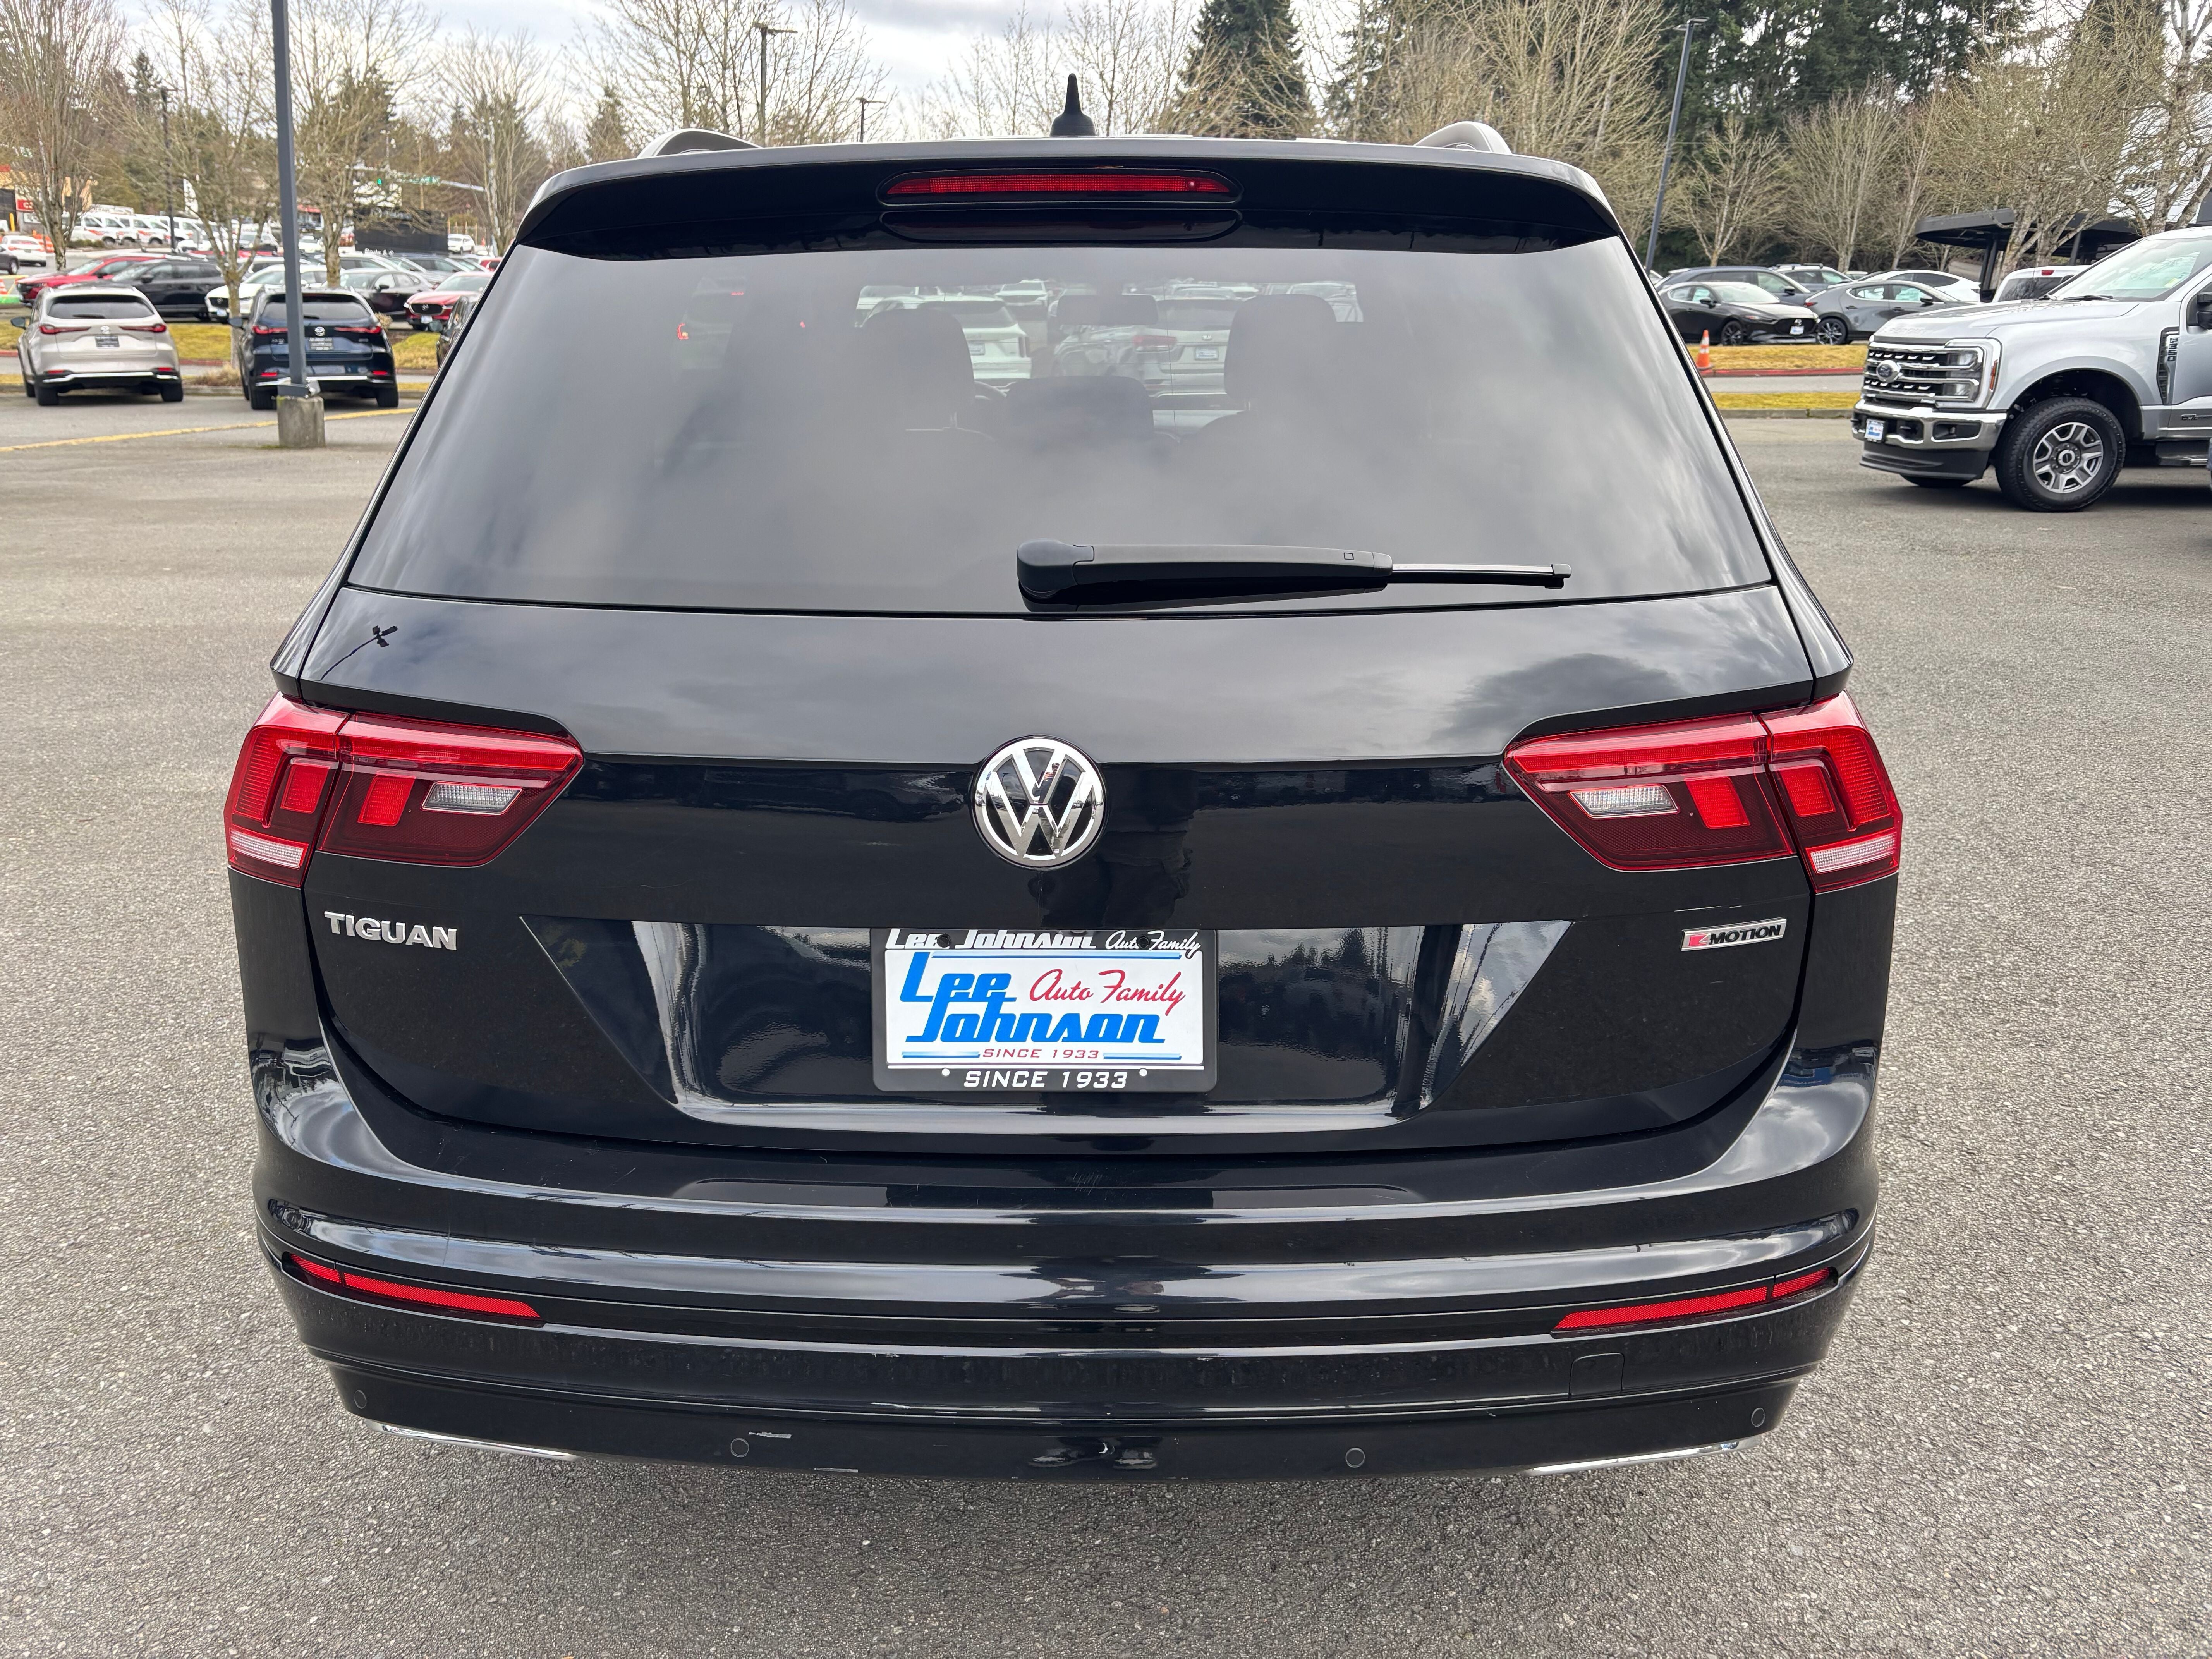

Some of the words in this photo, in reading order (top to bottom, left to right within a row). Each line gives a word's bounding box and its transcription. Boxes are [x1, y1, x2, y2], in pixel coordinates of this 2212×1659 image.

[324, 911, 457, 951] TIGUAN
[885, 928, 950, 949] Lee
[955, 929, 1096, 949] Johnson
[1105, 930, 1140, 950] Aut
[1147, 930, 1201, 958] Family
[900, 952, 1017, 1002] Lee
[1029, 969, 1094, 1003] Auto
[1098, 969, 1186, 1016] Family
[905, 999, 1166, 1044] Johnson
[982, 1049, 1042, 1058] SINCE
[1053, 1049, 1099, 1059] 1933
[964, 1071, 1048, 1088] SINCE
[1063, 1071, 1128, 1089] 1933
